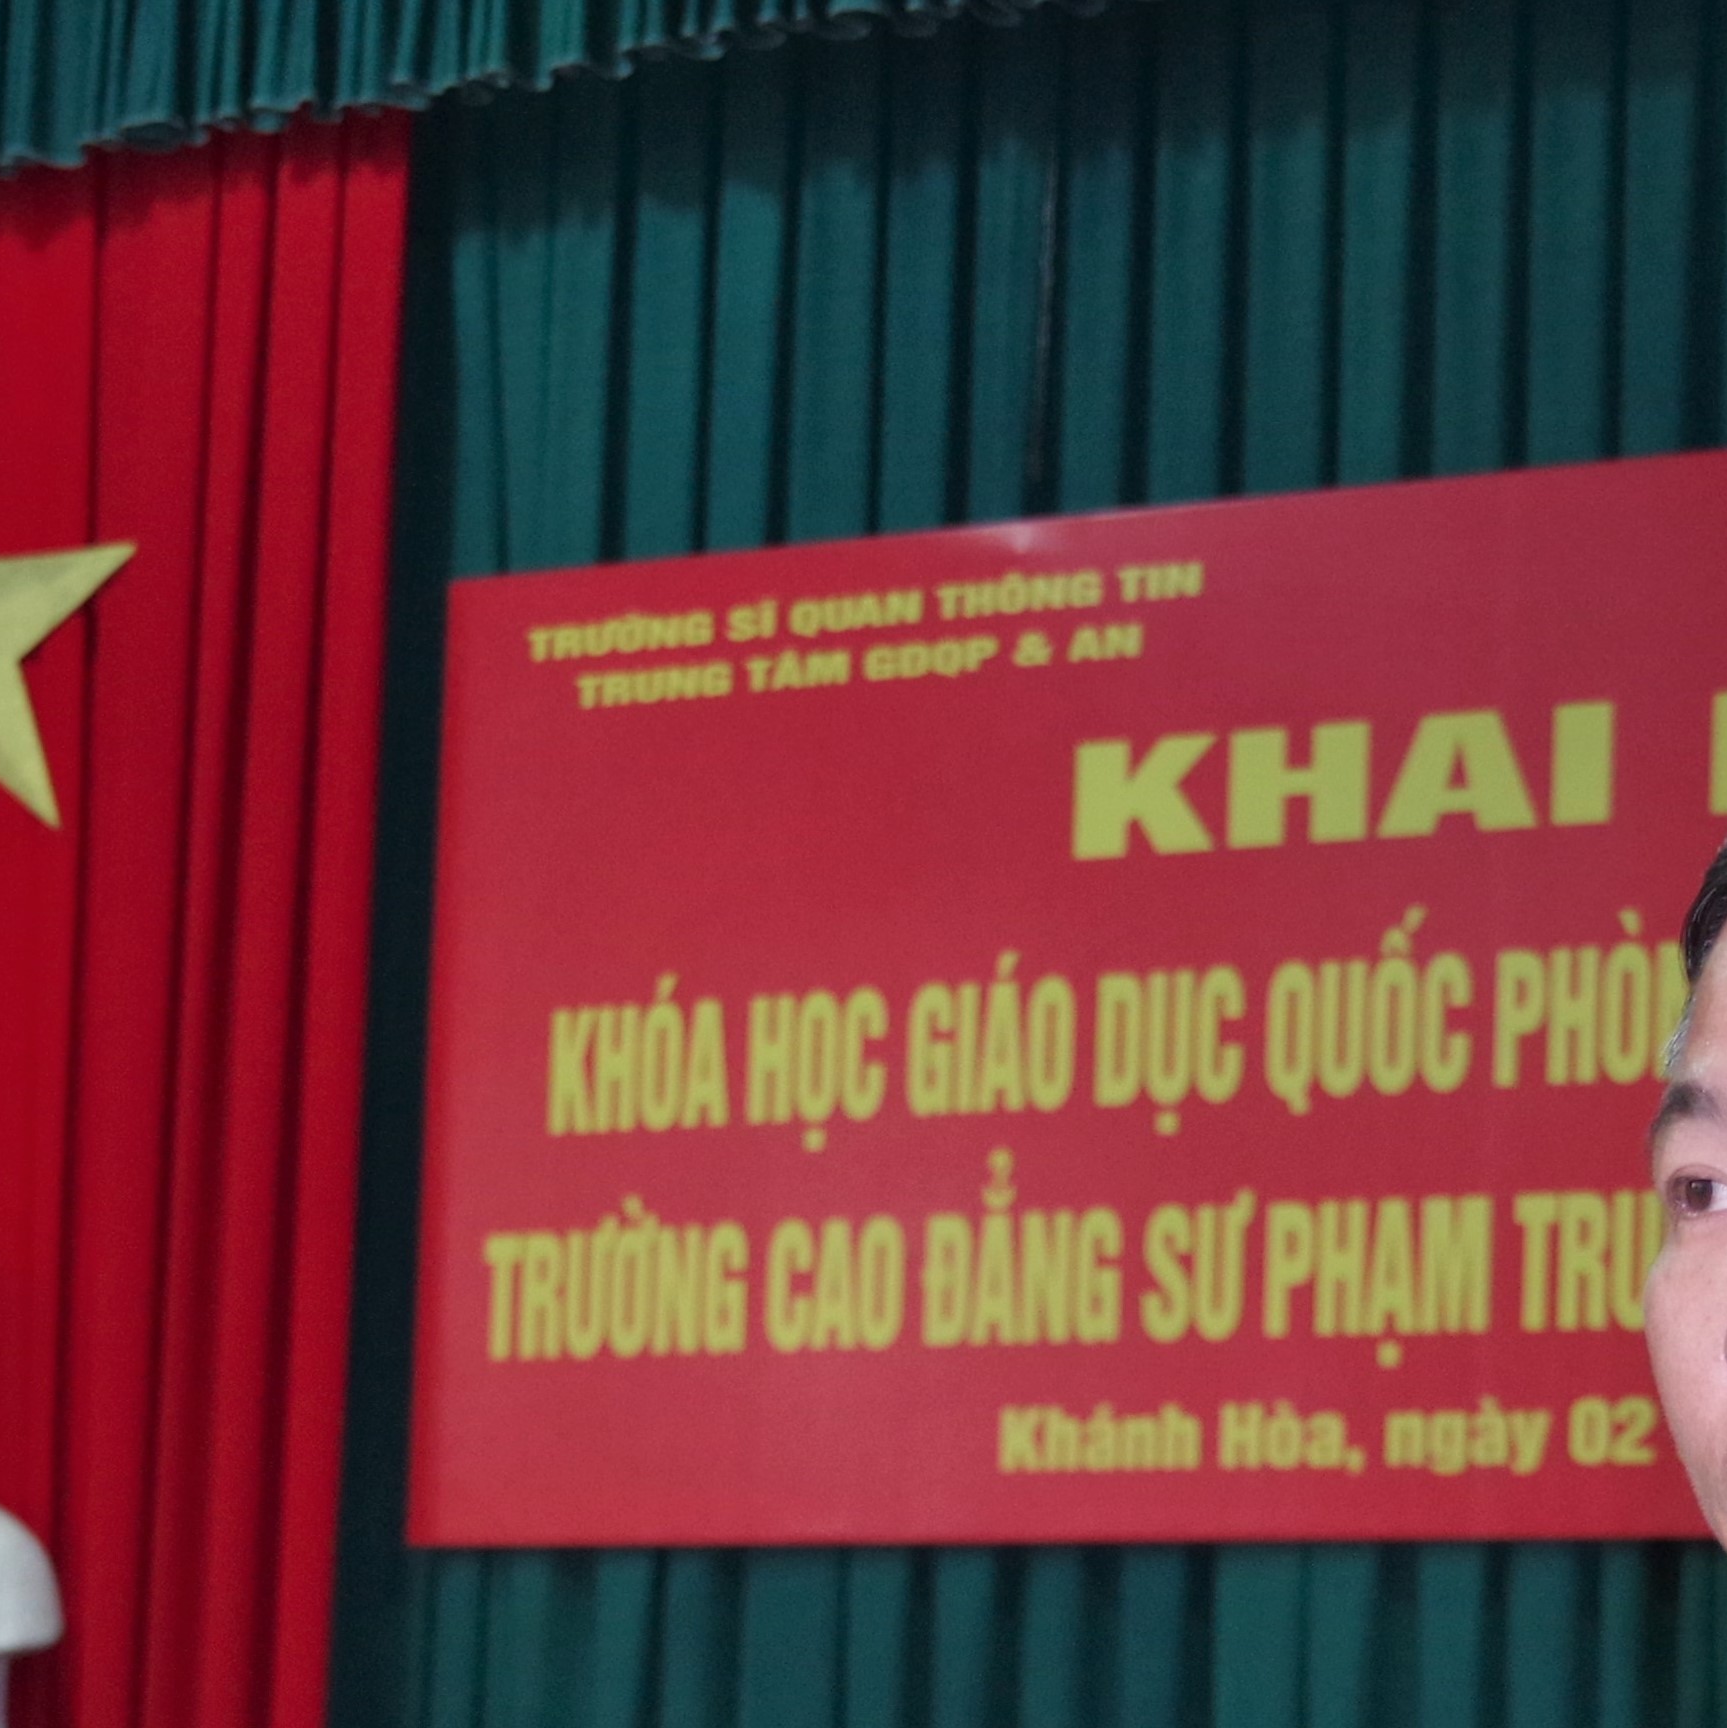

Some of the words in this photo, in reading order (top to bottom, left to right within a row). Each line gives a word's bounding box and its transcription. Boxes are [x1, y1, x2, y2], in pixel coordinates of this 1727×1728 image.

[790, 590, 922, 637] QUAN
[937, 570, 1103, 618] THÔNG
[1119, 562, 1202, 601] TIN
[577, 662, 731, 708] TRUNG
[747, 650, 851, 692] TÂM
[864, 635, 998, 680] GDQP
[1013, 631, 1050, 666] &
[1068, 624, 1143, 662] AN
[1073, 701, 1614, 860] KHAI
[547, 971, 729, 1136] KHÓA
[746, 985, 888, 1153] HỌC
[907, 949, 1075, 1117] GIÁO
[1094, 963, 1244, 1136] DỤC
[1266, 904, 1471, 1116] QUỐC
[484, 1193, 749, 1362] TRƯỜNG
[764, 1214, 906, 1352] CAO
[921, 1145, 1124, 1348] ĐẲNG
[1141, 1188, 1257, 1343] SƯ
[1263, 1194, 1492, 1368] PHẠM
[1000, 1403, 1201, 1474] Khánh
[1218, 1399, 1364, 1475] Hòa,
[1385, 1397, 1551, 1476] ngày
[1568, 1398, 1658, 1465] 02
